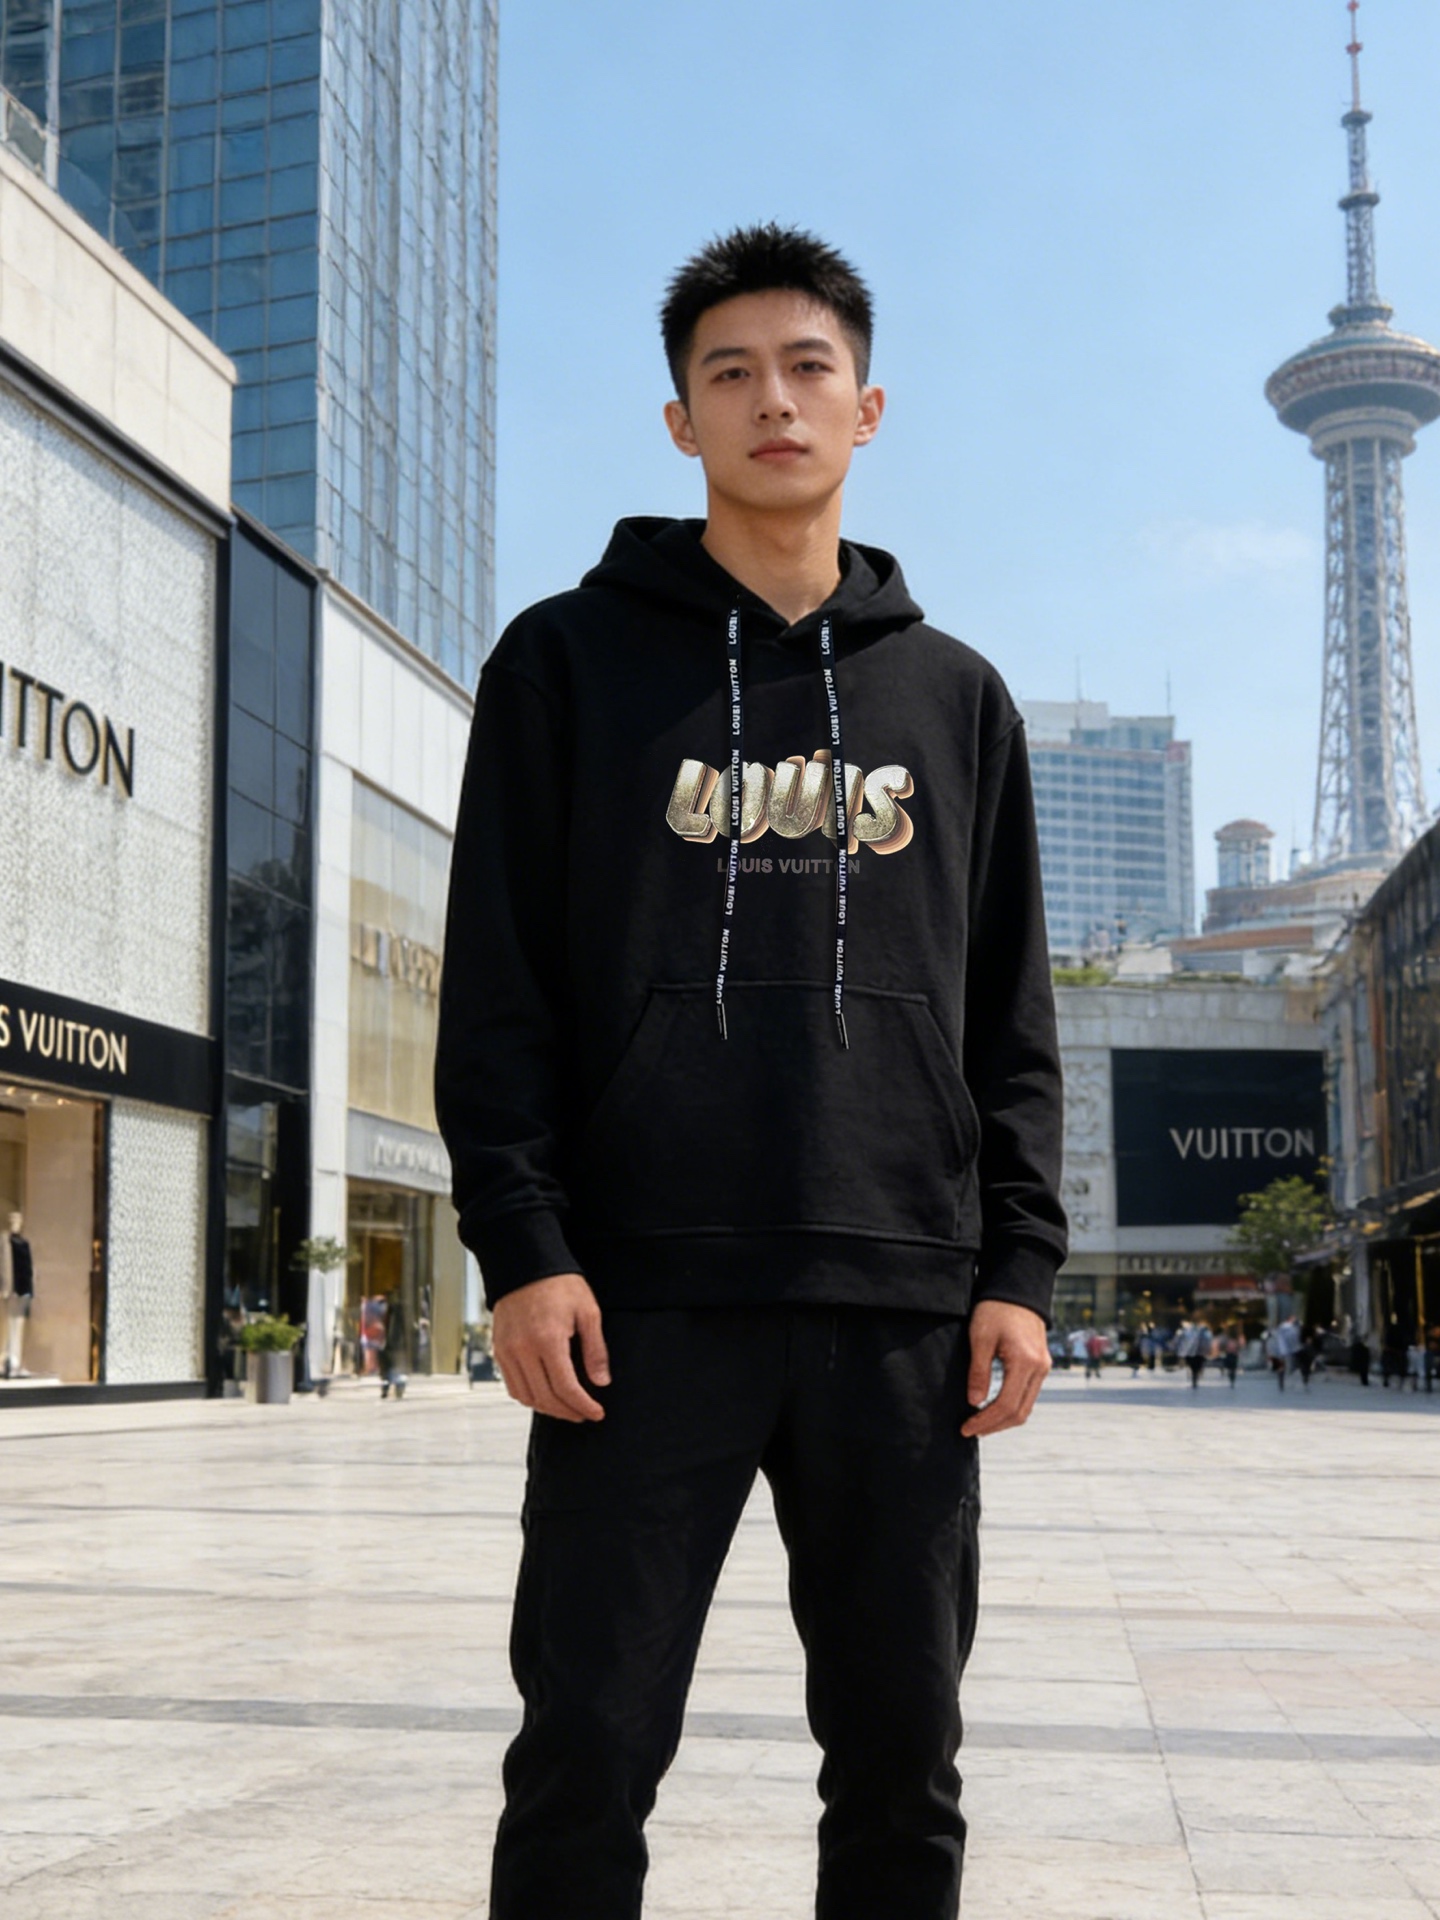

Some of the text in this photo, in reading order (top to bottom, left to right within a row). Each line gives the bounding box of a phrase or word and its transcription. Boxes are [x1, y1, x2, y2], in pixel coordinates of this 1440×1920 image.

[729, 658, 741, 702] VUITTON
[823, 668, 839, 712] VUITTON
[731, 749, 740, 793] VUITTON
[833, 758, 843, 802] VUITTON
[729, 839, 739, 882] VUITTON
[779, 859, 860, 874] VUITTN
[838, 849, 847, 892] VUITTON
[719, 929, 730, 971] VUITTON
[836, 938, 844, 981] VUITTON
[19, 1008, 127, 1075] VUITTON
[1169, 1127, 1316, 1159] VUITTON
